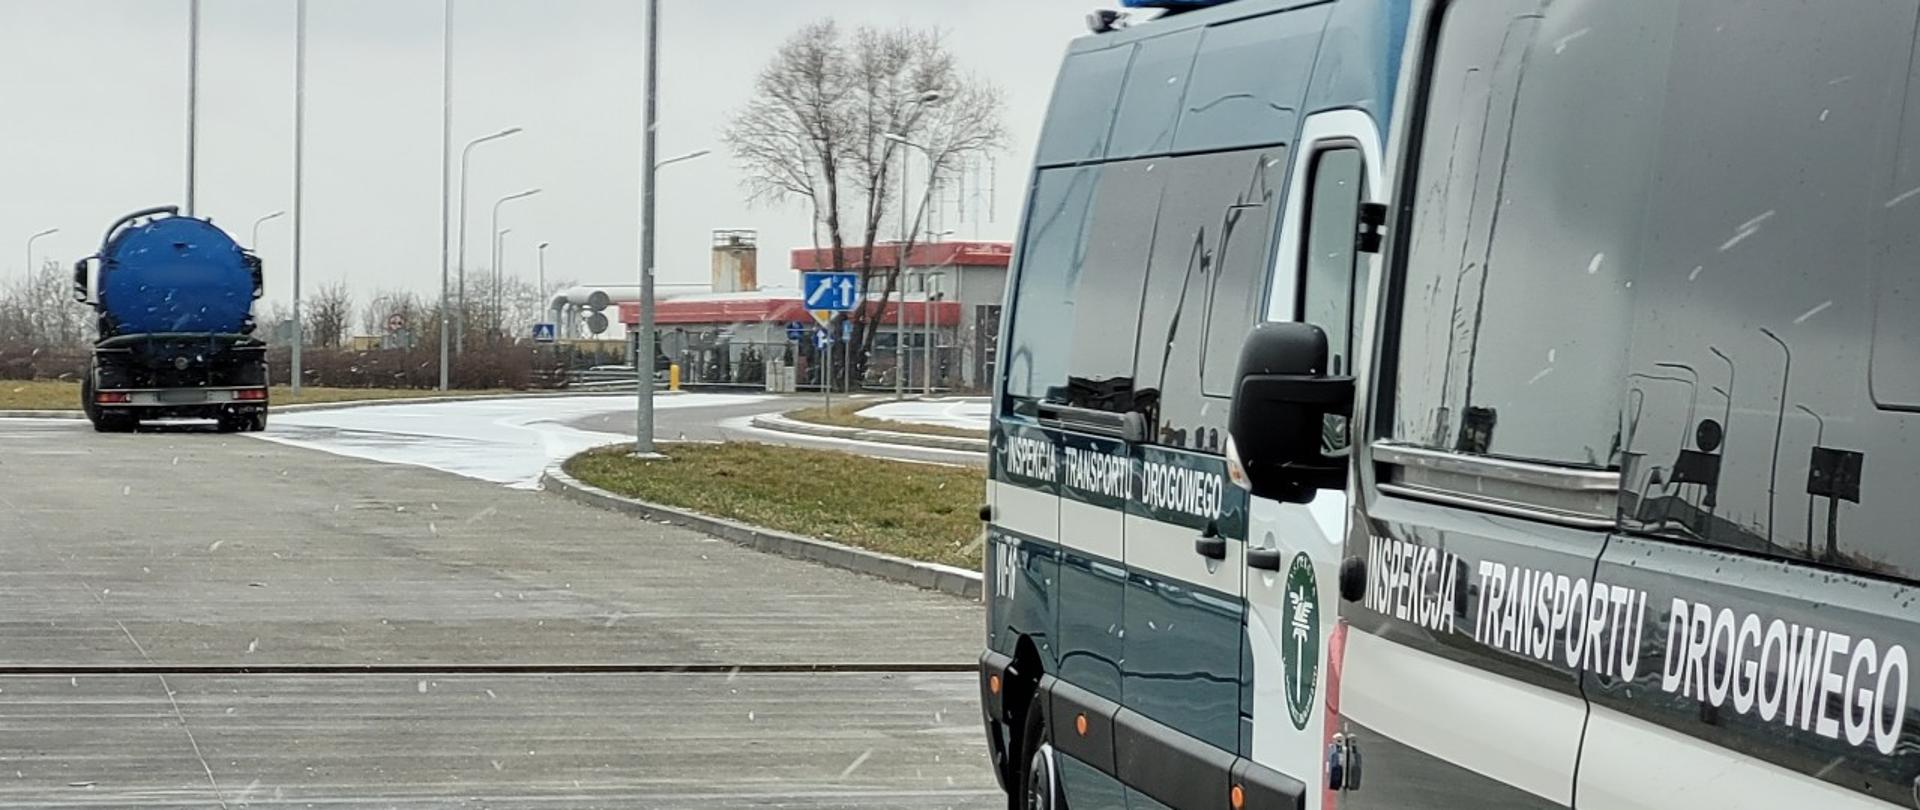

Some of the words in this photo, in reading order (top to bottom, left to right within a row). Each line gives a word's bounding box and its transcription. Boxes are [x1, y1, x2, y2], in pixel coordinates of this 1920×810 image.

[1007, 436, 1057, 483] INSPEKCJA
[1064, 447, 1133, 500] TRANSPORTU
[1142, 461, 1222, 520] DROGOWEGO
[1365, 535, 1458, 635] INSPEKCJA
[1475, 560, 1648, 683] TRANSPORTU
[1662, 597, 1909, 755] DROGOWEGO
